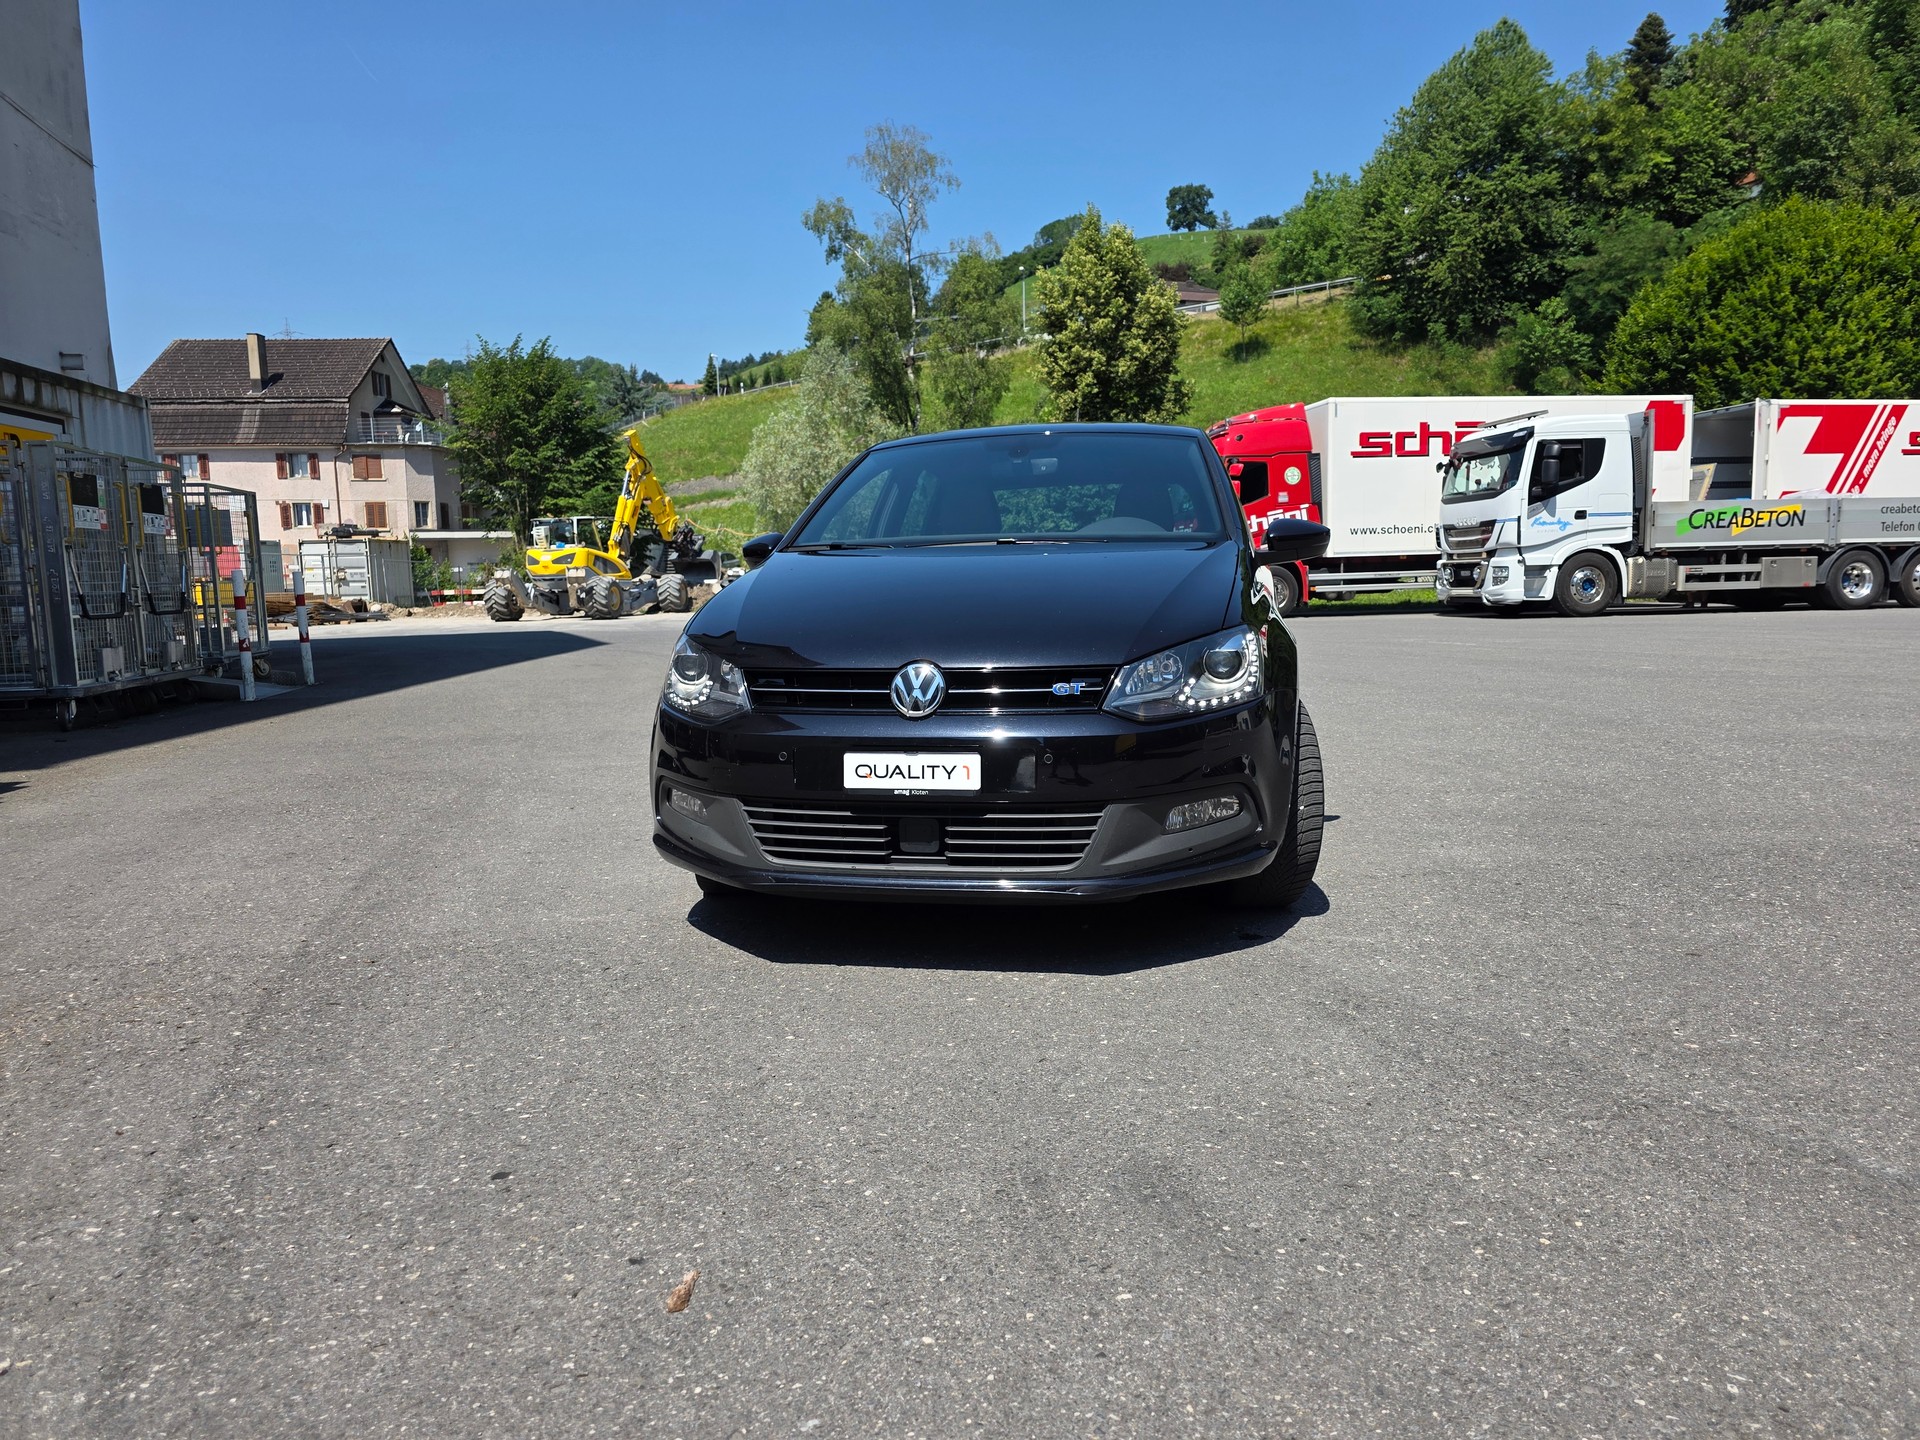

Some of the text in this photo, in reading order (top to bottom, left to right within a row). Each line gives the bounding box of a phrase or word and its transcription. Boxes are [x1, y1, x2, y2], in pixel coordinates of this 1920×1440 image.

[1881, 521, 1915, 532] Telefon
[1052, 682, 1086, 695] GT
[855, 764, 970, 780] QUALITY 1
